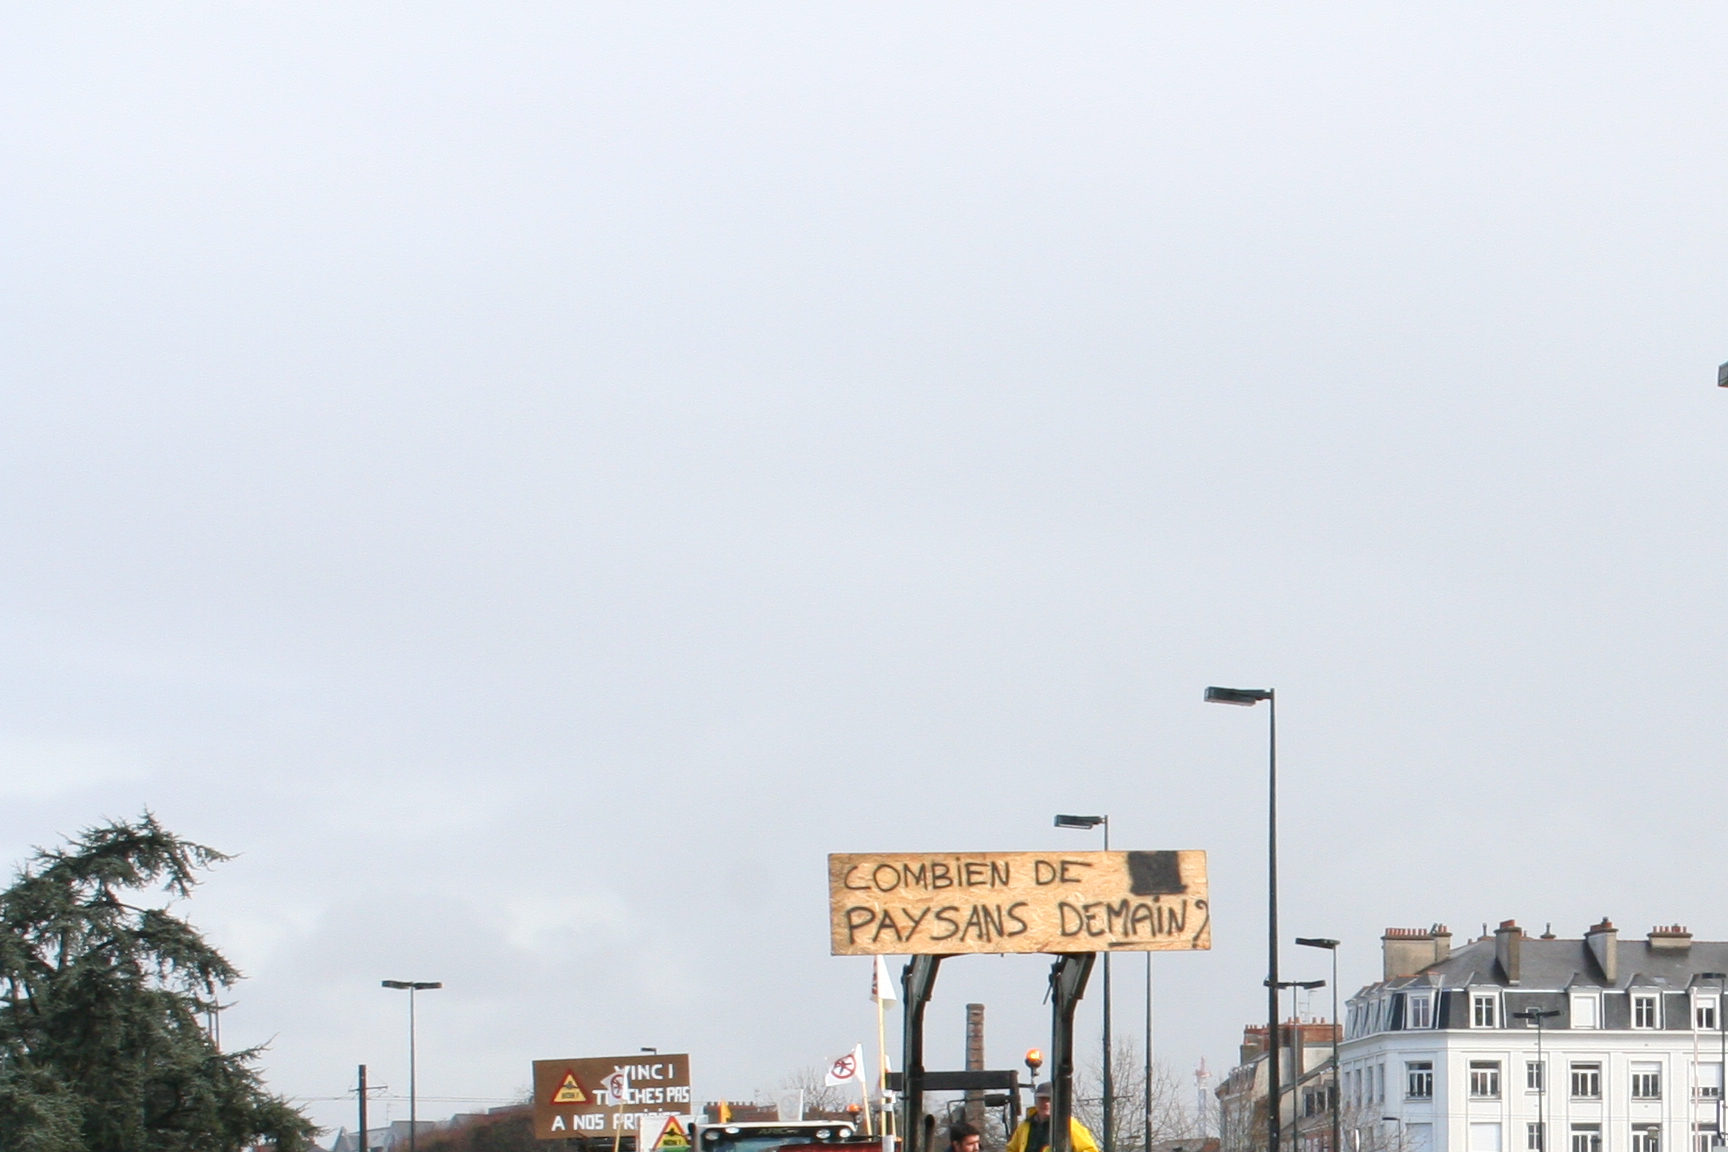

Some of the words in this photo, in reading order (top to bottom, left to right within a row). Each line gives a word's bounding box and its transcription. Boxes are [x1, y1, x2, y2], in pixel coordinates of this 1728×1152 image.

[844, 857, 1010, 892] COMBIEN
[1035, 859, 1093, 885] DE
[845, 902, 1030, 945] PAYSANS
[666, 1086, 690, 1103] PAS
[551, 1116, 566, 1131] A
[573, 1114, 605, 1130] NOS
